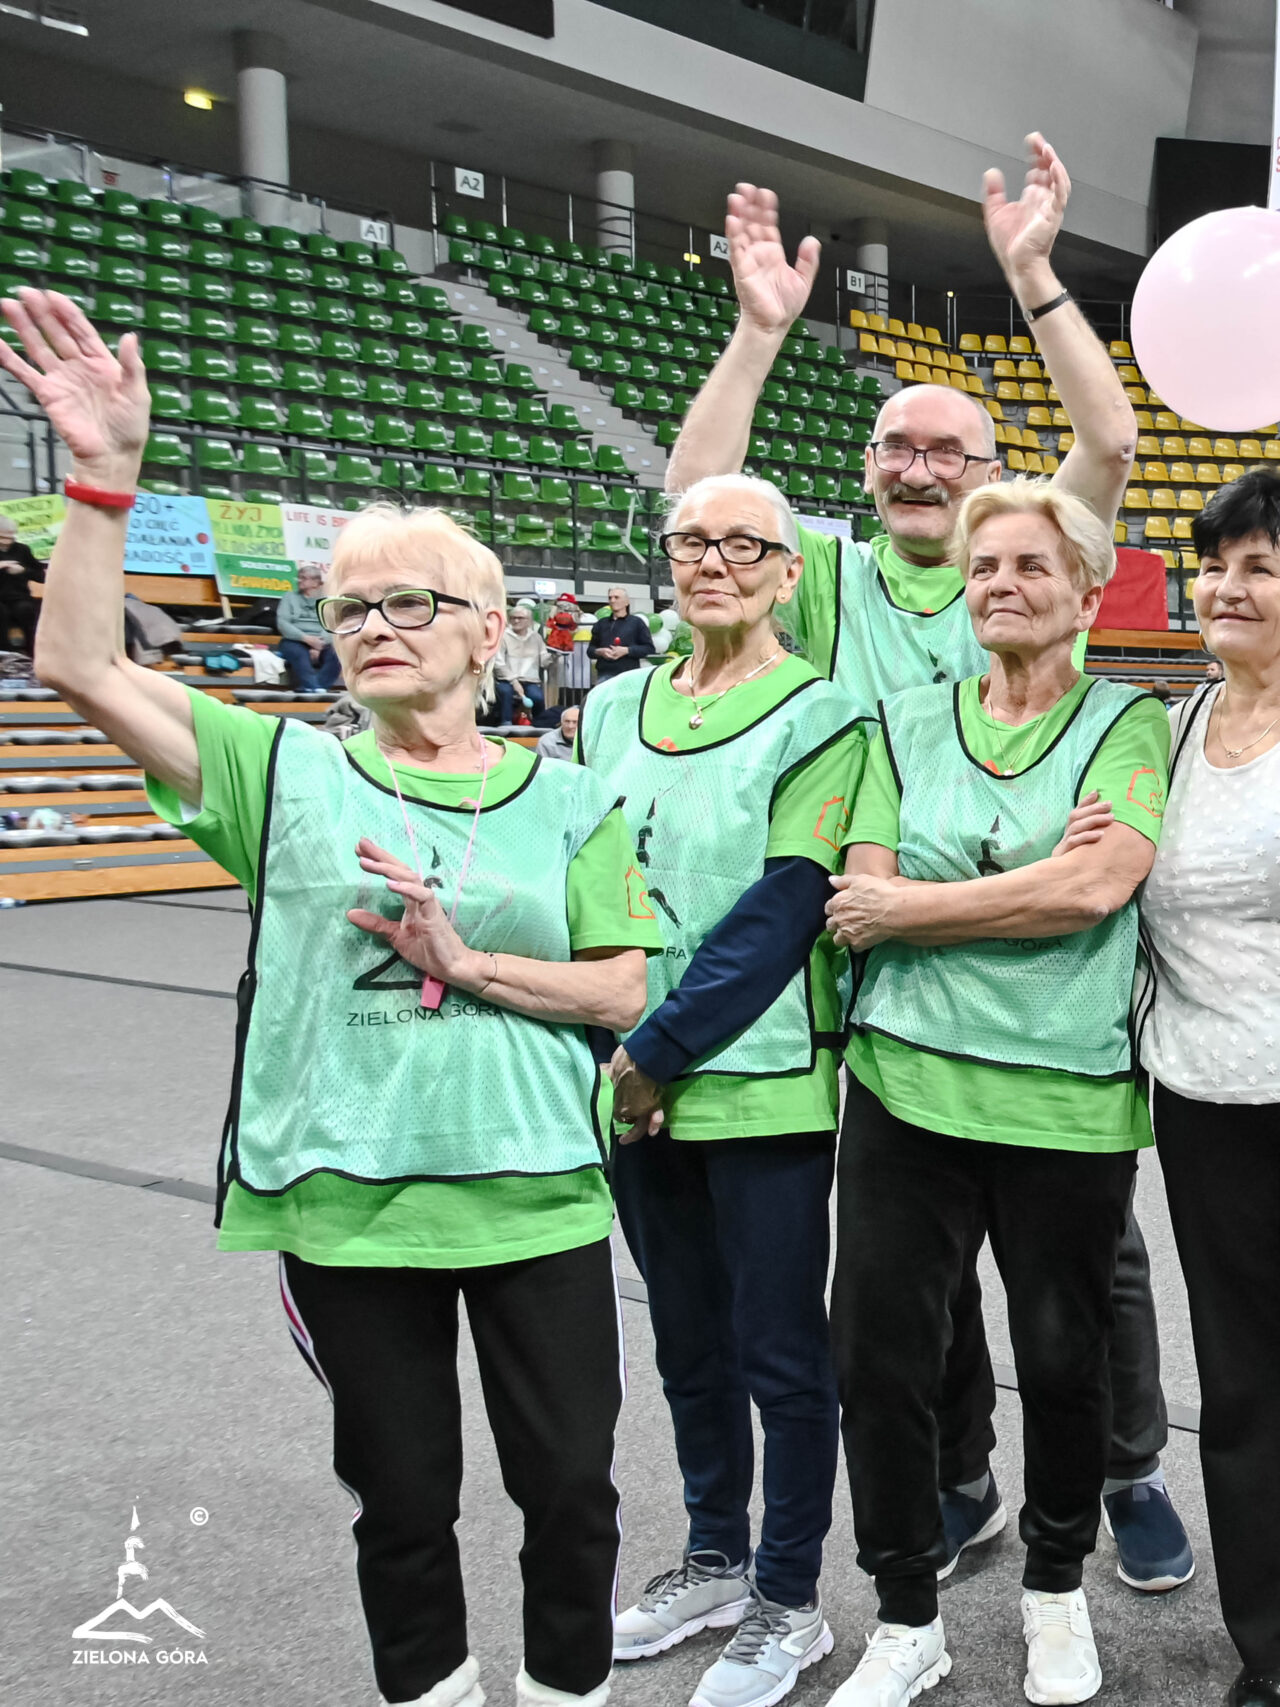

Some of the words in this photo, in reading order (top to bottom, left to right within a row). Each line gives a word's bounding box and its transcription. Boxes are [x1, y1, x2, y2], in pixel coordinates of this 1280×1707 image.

[460, 175, 480, 192] A2
[365, 223, 385, 241] A1
[851, 275, 862, 288] B1
[286, 511, 310, 523] LIFE
[316, 515, 327, 526] IS
[305, 537, 330, 550] AND
[346, 1008, 445, 1027] ZIELONA
